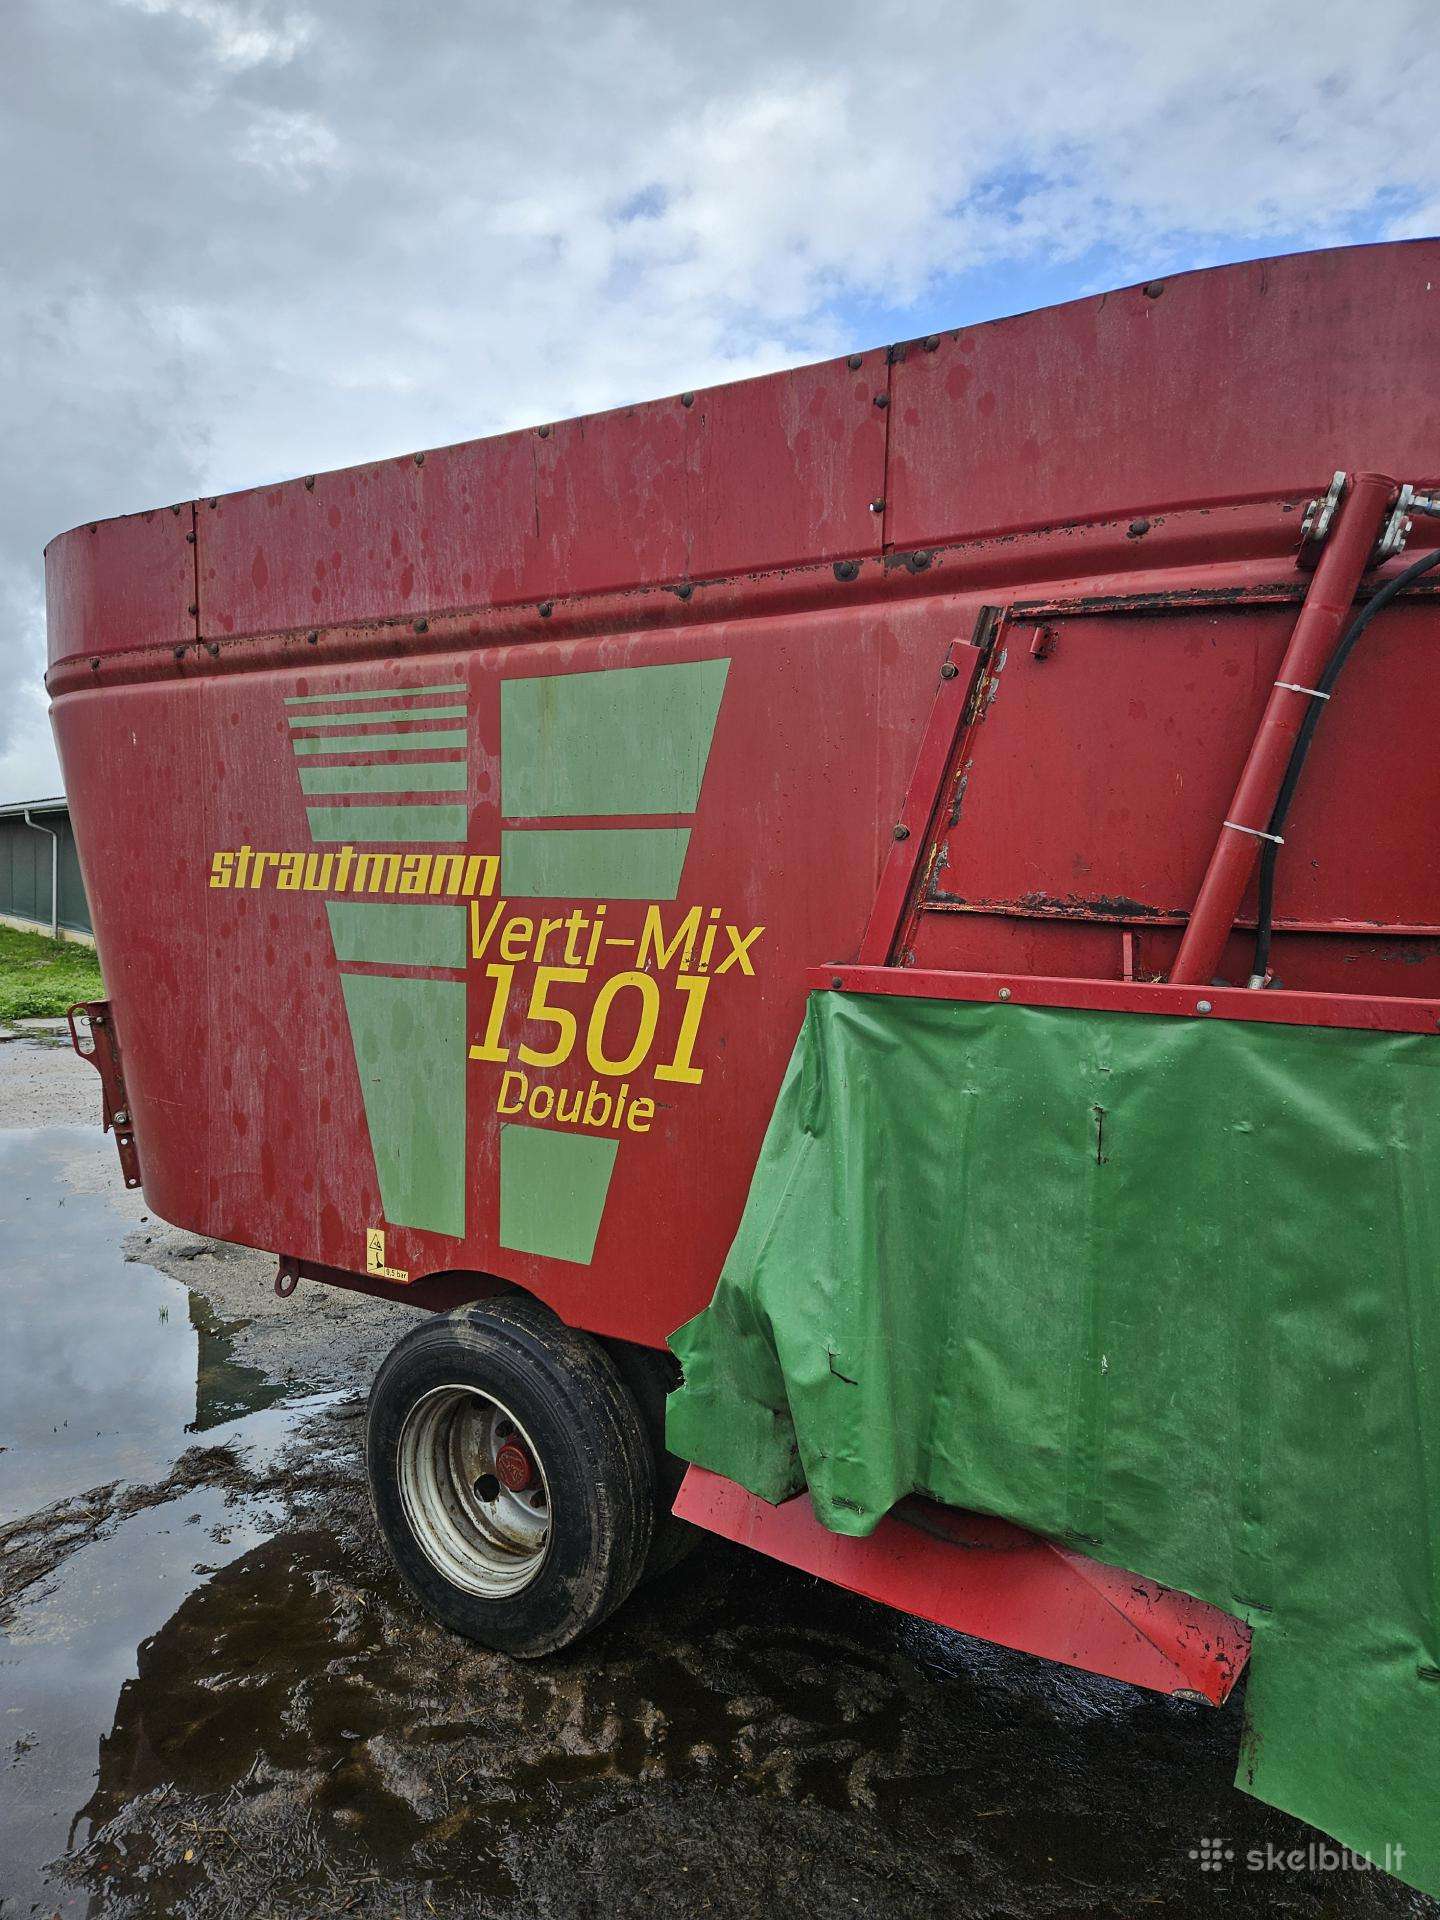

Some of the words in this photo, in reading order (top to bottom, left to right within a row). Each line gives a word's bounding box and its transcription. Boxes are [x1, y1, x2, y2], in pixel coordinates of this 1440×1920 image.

[210, 846, 500, 897] strautmann
[469, 900, 766, 976] Verti-Mix
[468, 963, 711, 1085] 1501
[496, 1070, 655, 1132] Double
